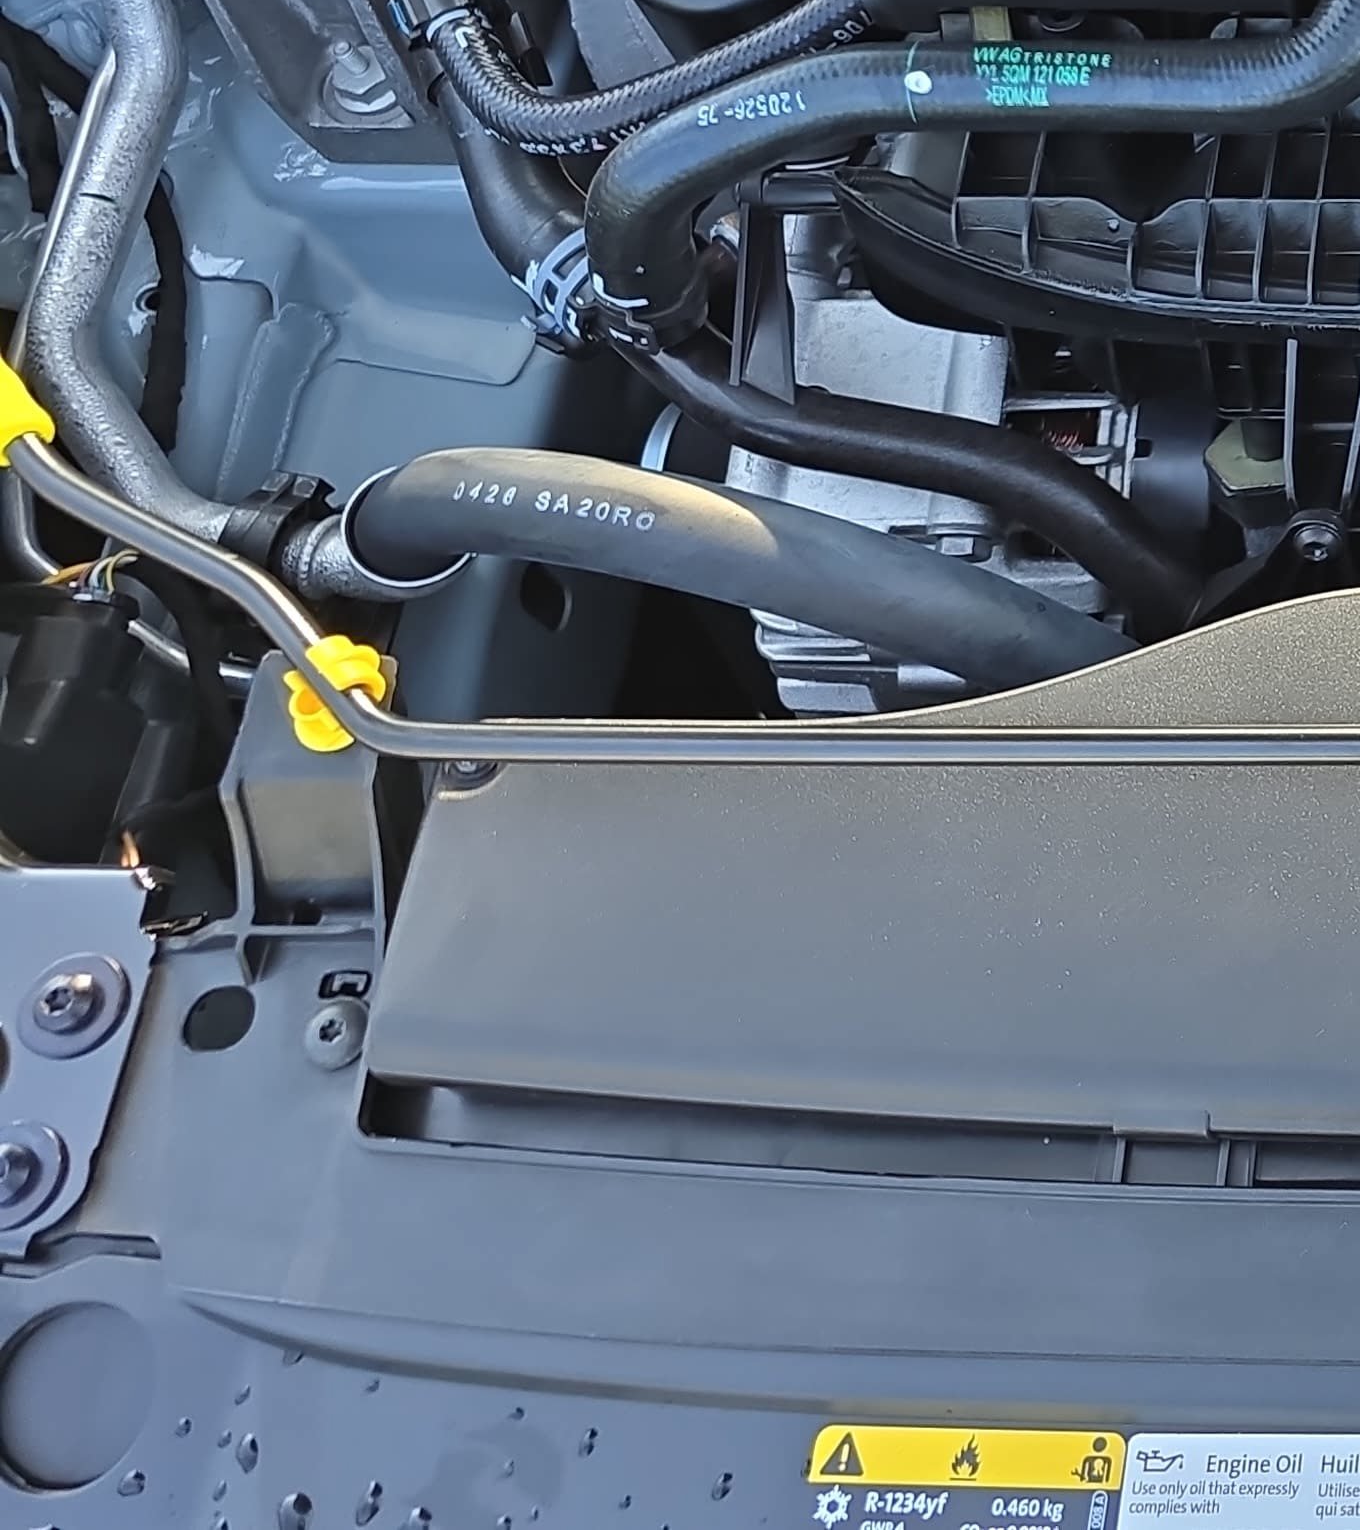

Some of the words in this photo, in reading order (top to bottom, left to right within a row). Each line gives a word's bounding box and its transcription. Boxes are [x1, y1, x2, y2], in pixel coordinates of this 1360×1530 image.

[1206, 1454, 1271, 1479] Engine
[1276, 1453, 1303, 1474] Oil
[1132, 1481, 1156, 1495] Use
[1159, 1481, 1188, 1500] only
[1190, 1480, 1205, 1495] oil
[1208, 1481, 1236, 1496] that
[1238, 1480, 1300, 1500] expressly
[864, 1491, 950, 1516] R-1234yf
[992, 1498, 1040, 1517] 0.460
[1044, 1500, 1064, 1522] kg
[1128, 1499, 1187, 1518] complies
[1190, 1500, 1220, 1514] with
[1315, 1503, 1337, 1520] qui
